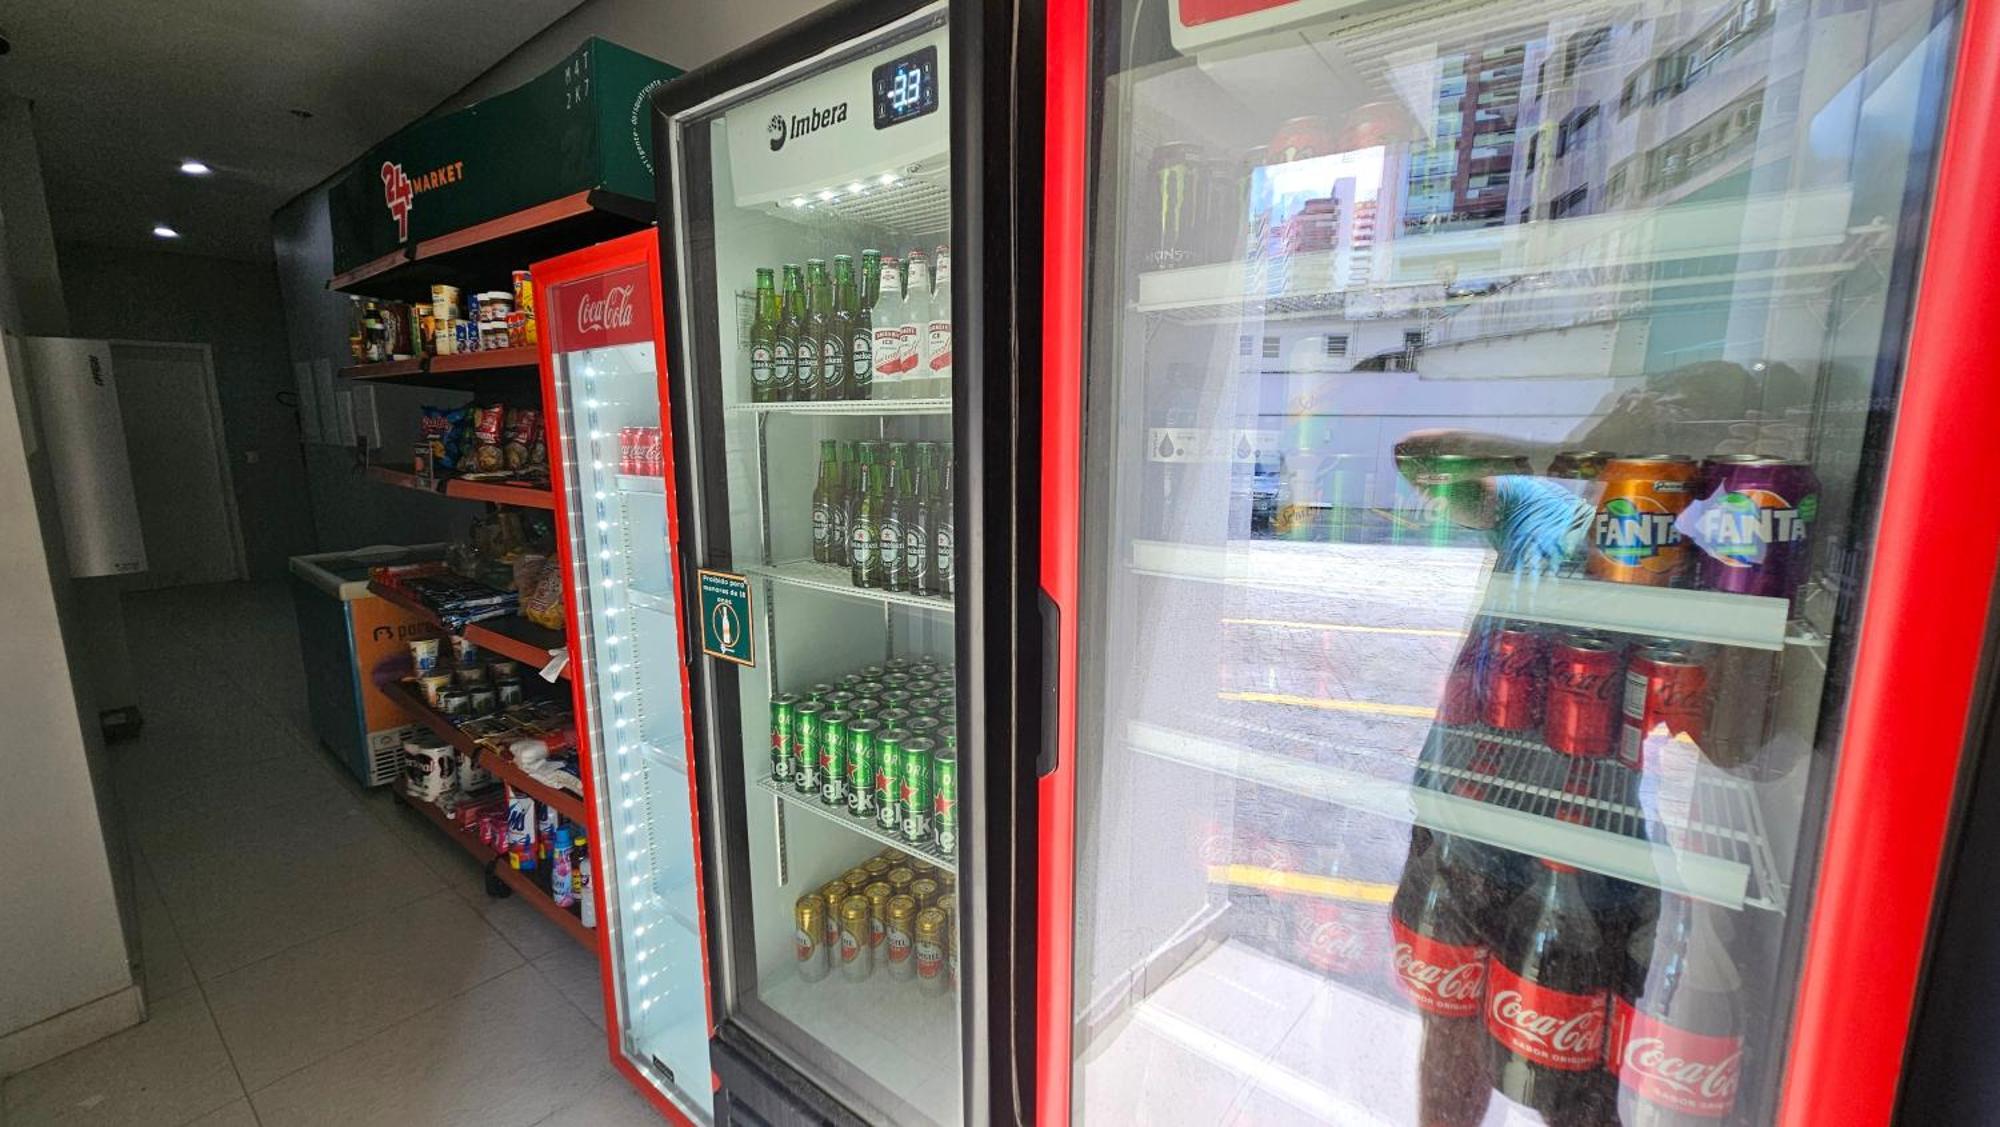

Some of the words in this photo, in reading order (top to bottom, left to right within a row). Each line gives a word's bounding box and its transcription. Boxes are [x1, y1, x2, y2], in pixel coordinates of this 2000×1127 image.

[790, 102, 847, 140] Imbera
[413, 161, 464, 194] MARKET
[578, 285, 634, 334] Coca-Cola
[1596, 514, 1682, 545] FANTA
[1700, 508, 1807, 543] FANTA
